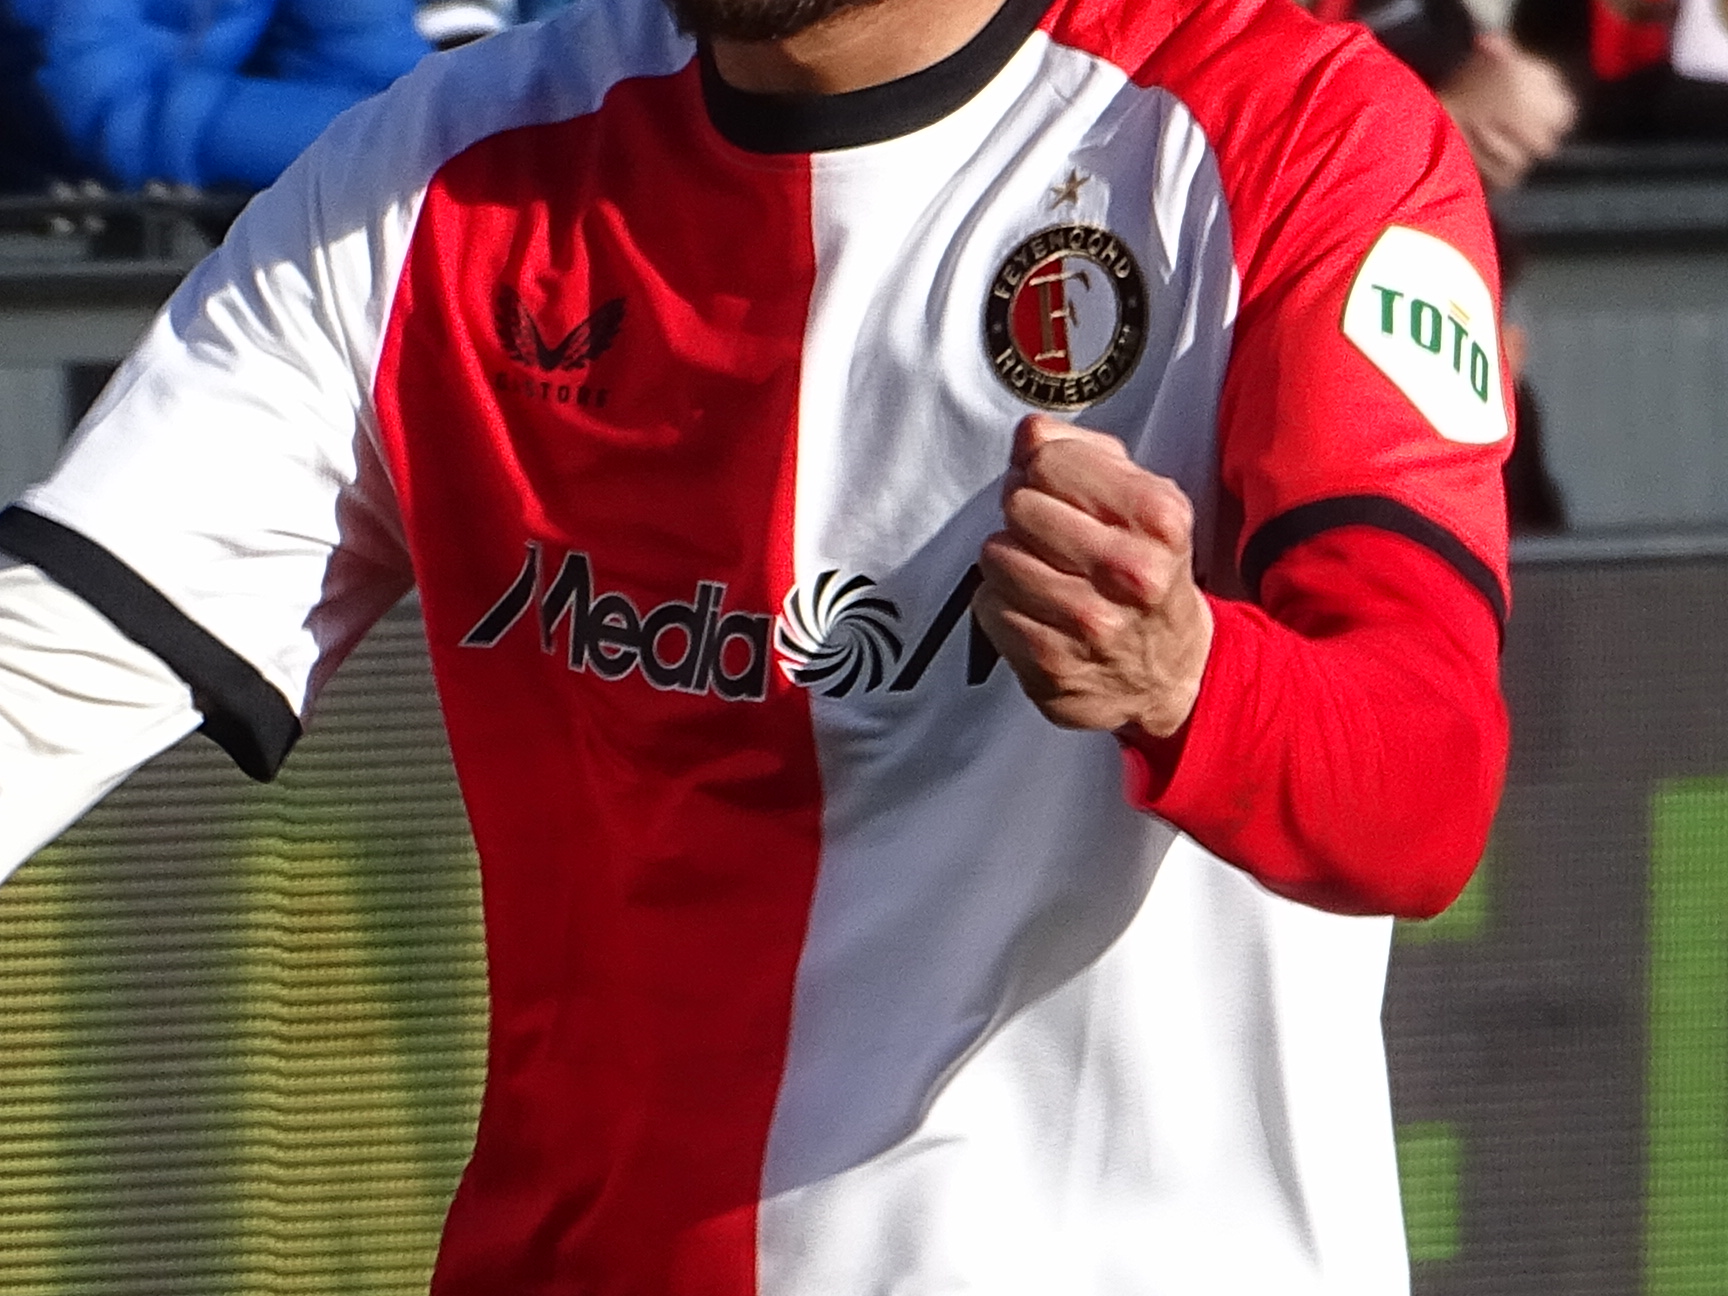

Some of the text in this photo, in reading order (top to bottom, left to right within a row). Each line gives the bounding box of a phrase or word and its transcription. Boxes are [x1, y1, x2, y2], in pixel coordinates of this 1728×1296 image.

[995, 324, 1140, 402] ROTTERD
[1371, 283, 1489, 404] TOTO
[460, 540, 773, 702] Media
